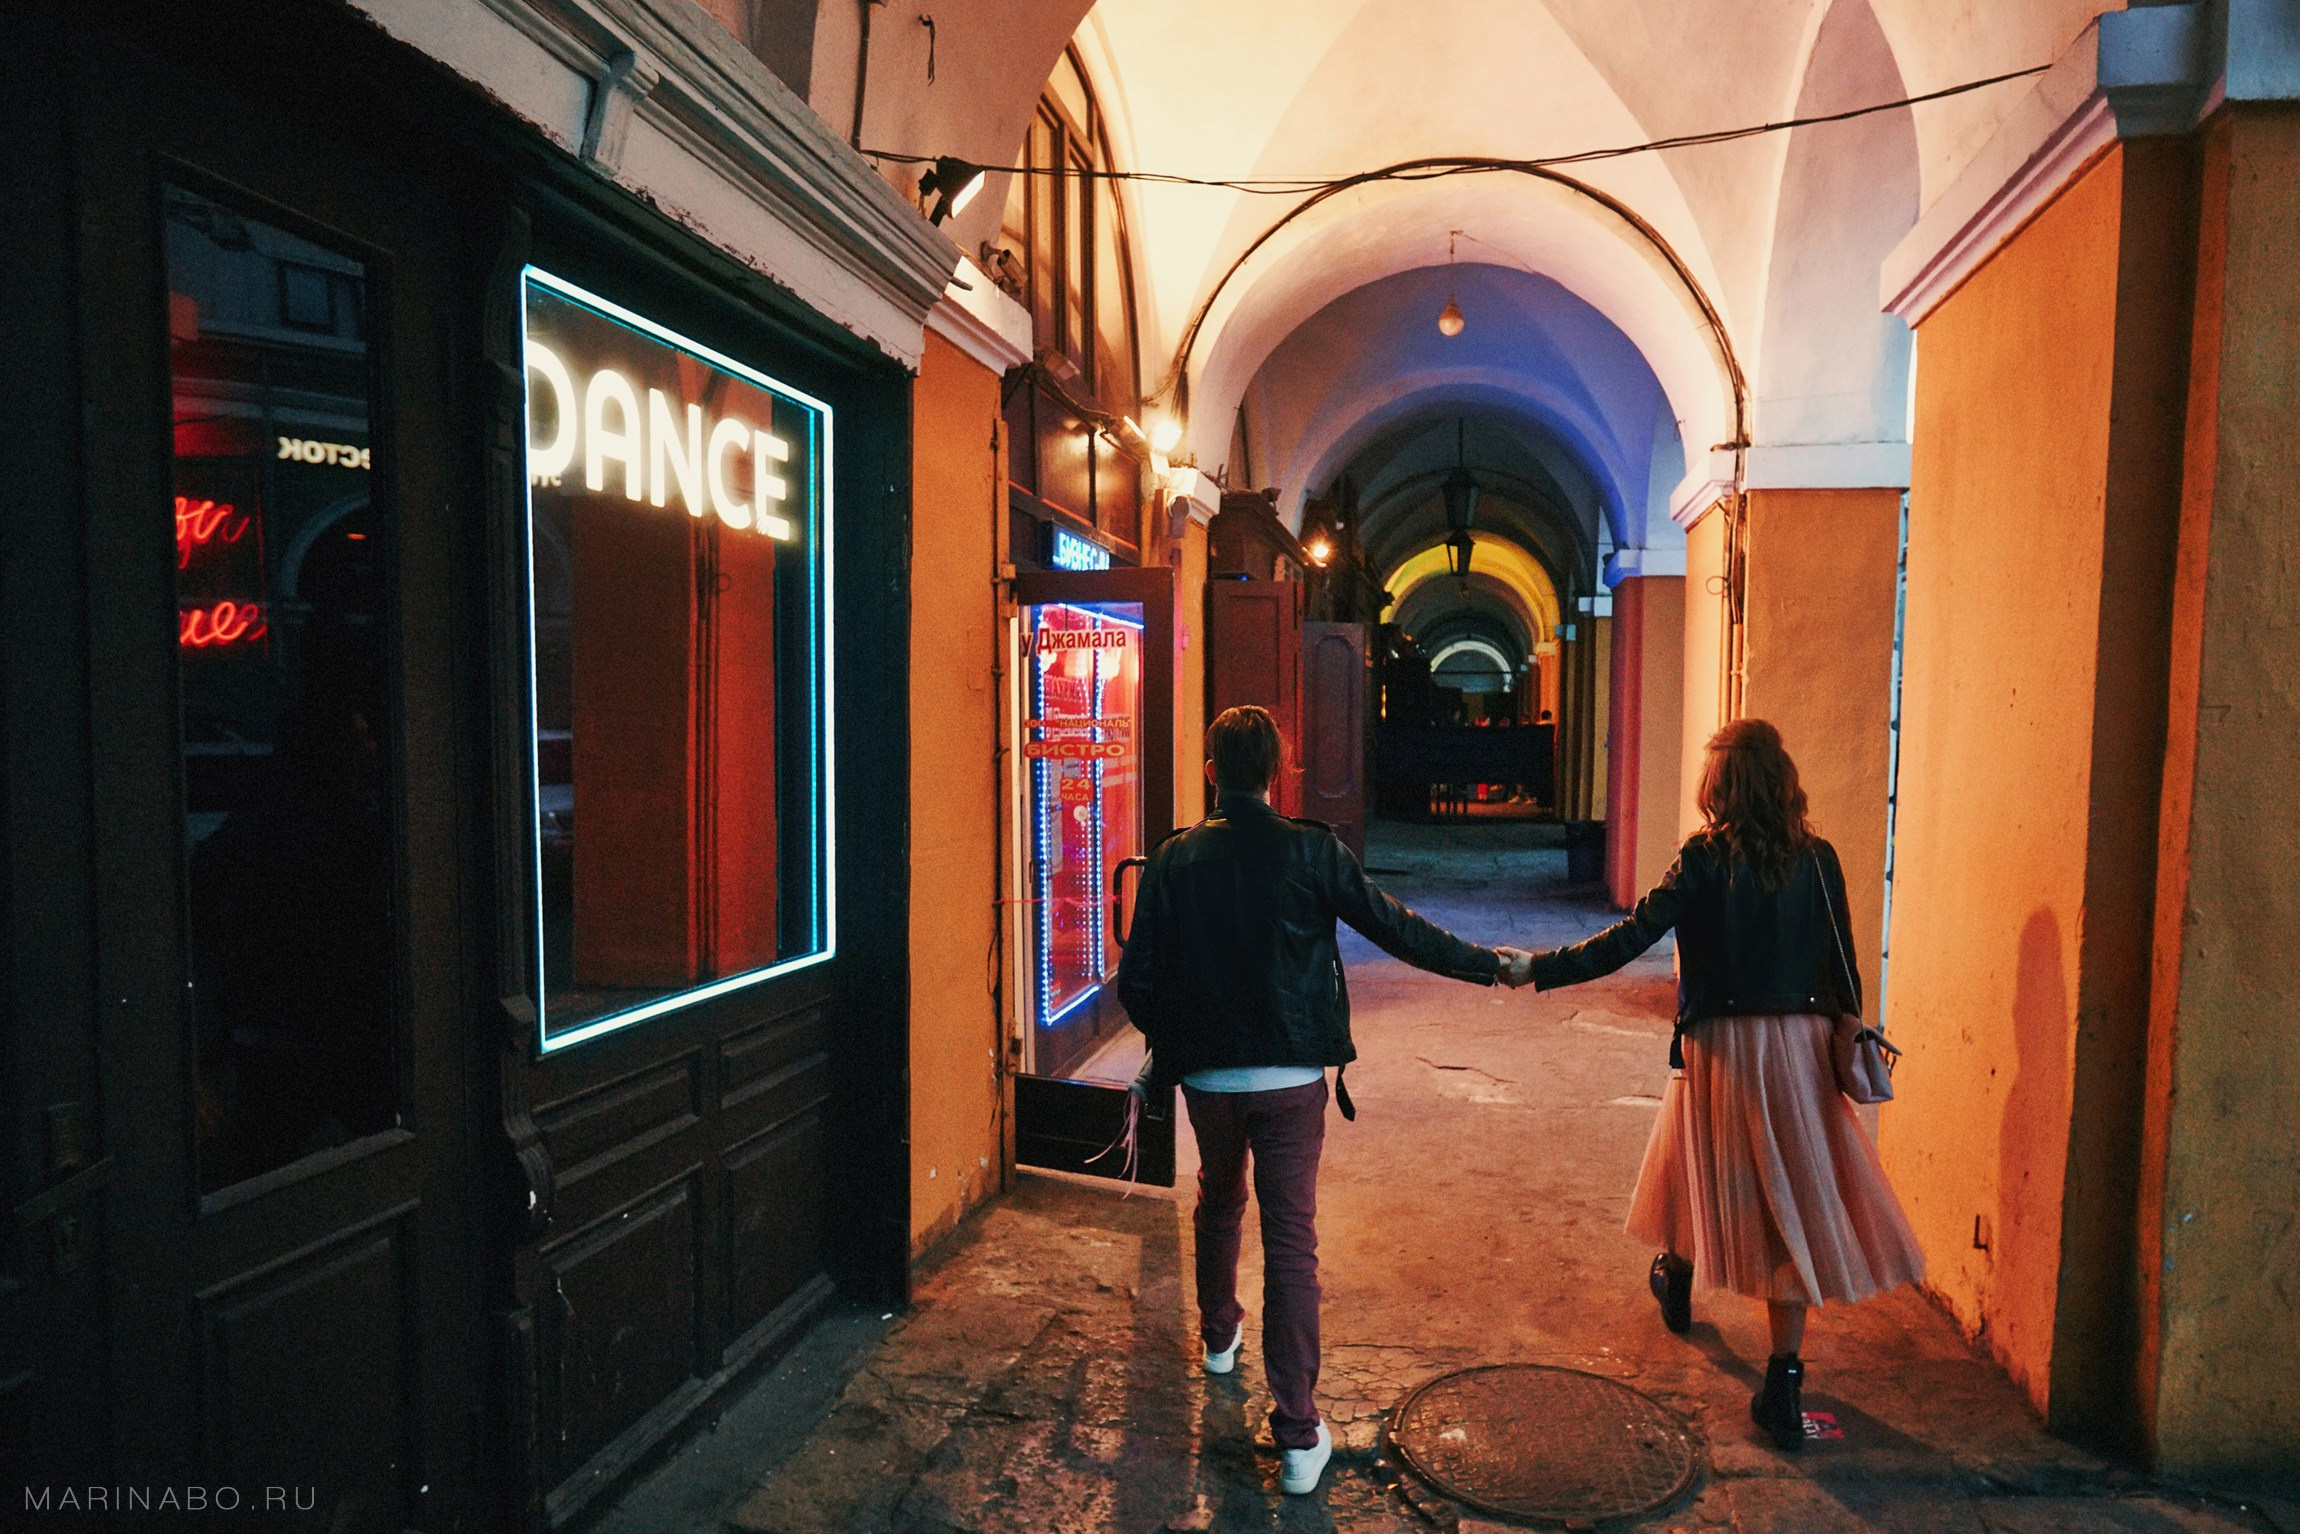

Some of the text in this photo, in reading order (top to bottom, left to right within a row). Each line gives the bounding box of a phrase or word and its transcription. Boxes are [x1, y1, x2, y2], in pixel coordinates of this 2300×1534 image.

[527, 339, 790, 541] DANCE
[1037, 627, 1126, 653] Джамала
[1027, 744, 1125, 756] БИСТРО
[1061, 778, 1091, 791] 24
[1061, 793, 1090, 802] ЧАСА
